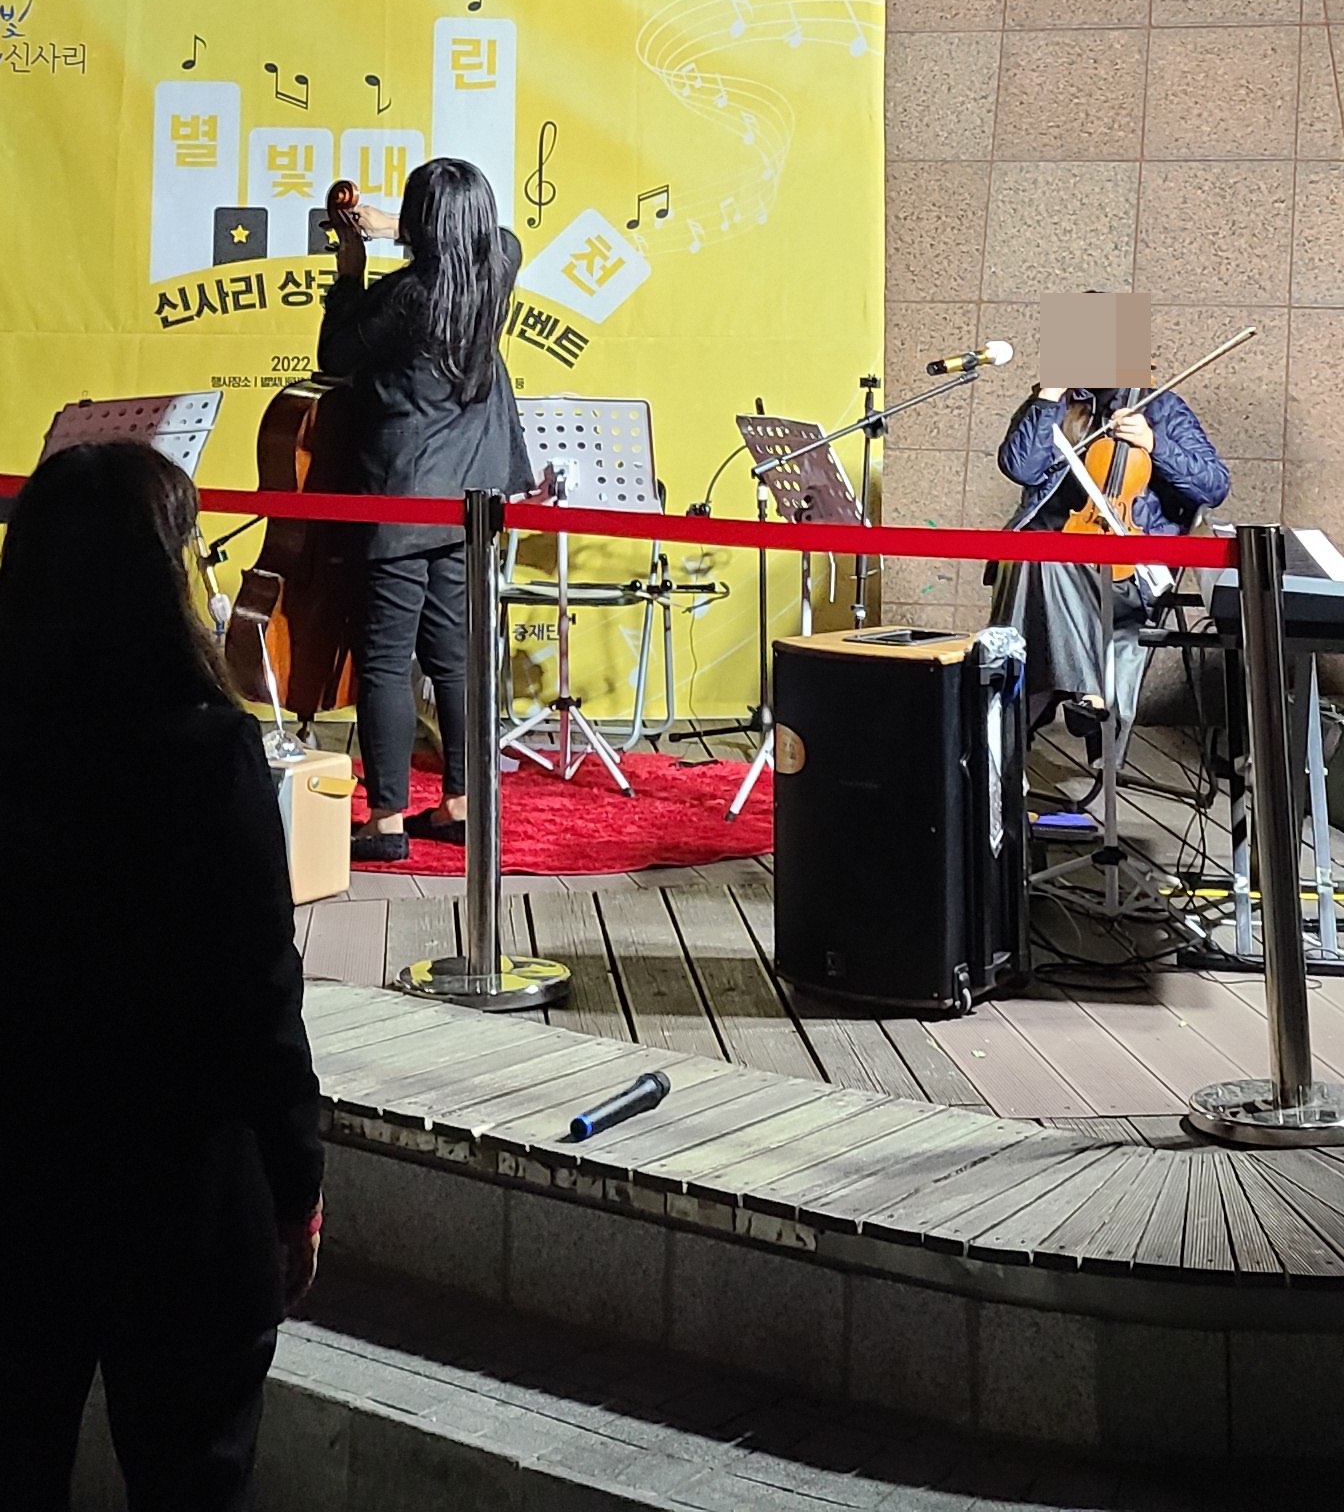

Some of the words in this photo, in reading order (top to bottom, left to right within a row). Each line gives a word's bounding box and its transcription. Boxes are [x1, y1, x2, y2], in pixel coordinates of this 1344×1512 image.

[4, 42, 87, 75] 신사리
[170, 114, 218, 168] 별
[267, 143, 314, 198] 빛
[451, 37, 498, 90] 린
[155, 272, 268, 330] 신사리
[211, 376, 252, 388] 행사장소
